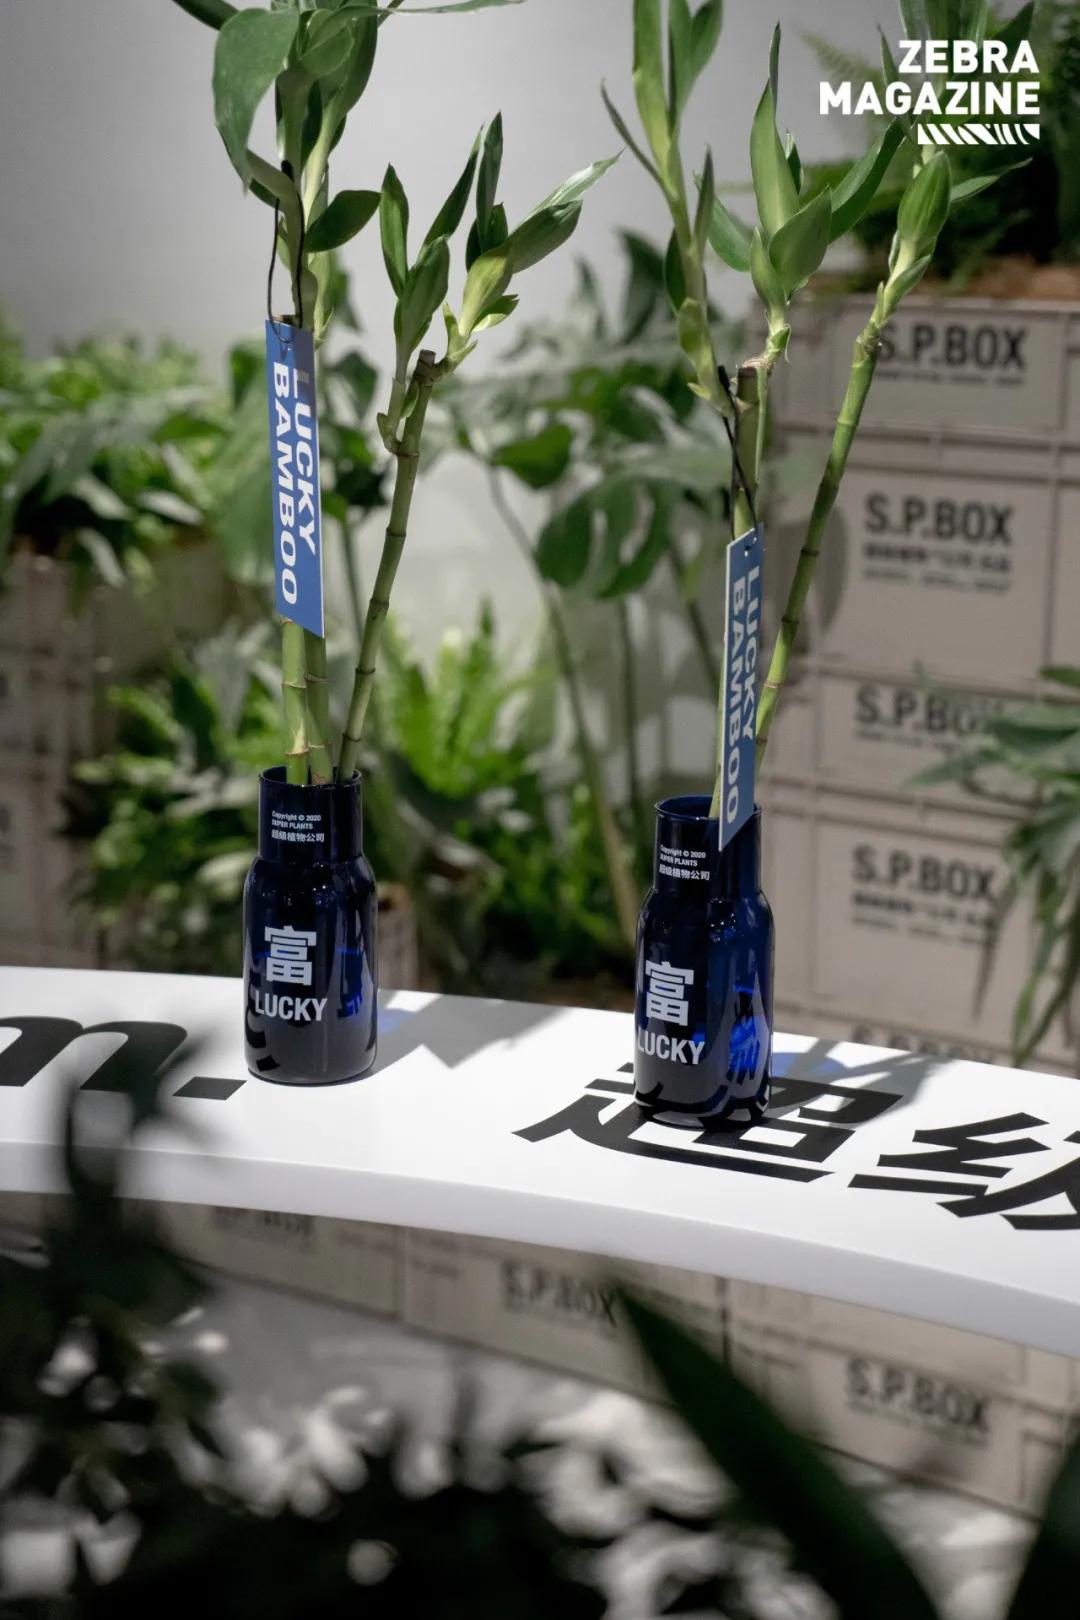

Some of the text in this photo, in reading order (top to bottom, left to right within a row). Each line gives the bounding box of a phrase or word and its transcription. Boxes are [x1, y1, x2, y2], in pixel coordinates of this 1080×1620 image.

[273, 361, 298, 606] BAMBOO
[292, 368, 316, 556] LUCKY
[865, 492, 1013, 546] S.P.BOX
[742, 566, 760, 741] LUCKY
[726, 576, 746, 825] BAMBOO
[289, 822, 314, 830] PLANTS
[306, 814, 321, 822] 2020
[674, 857, 698, 867] PLANTS
[690, 850, 706, 859] 2020
[853, 843, 995, 899] S.P.BOX
[264, 925, 317, 986] 富
[255, 990, 328, 1023] LUCKY
[644, 961, 695, 1027] 富
[636, 1025, 706, 1066] LUCKY
